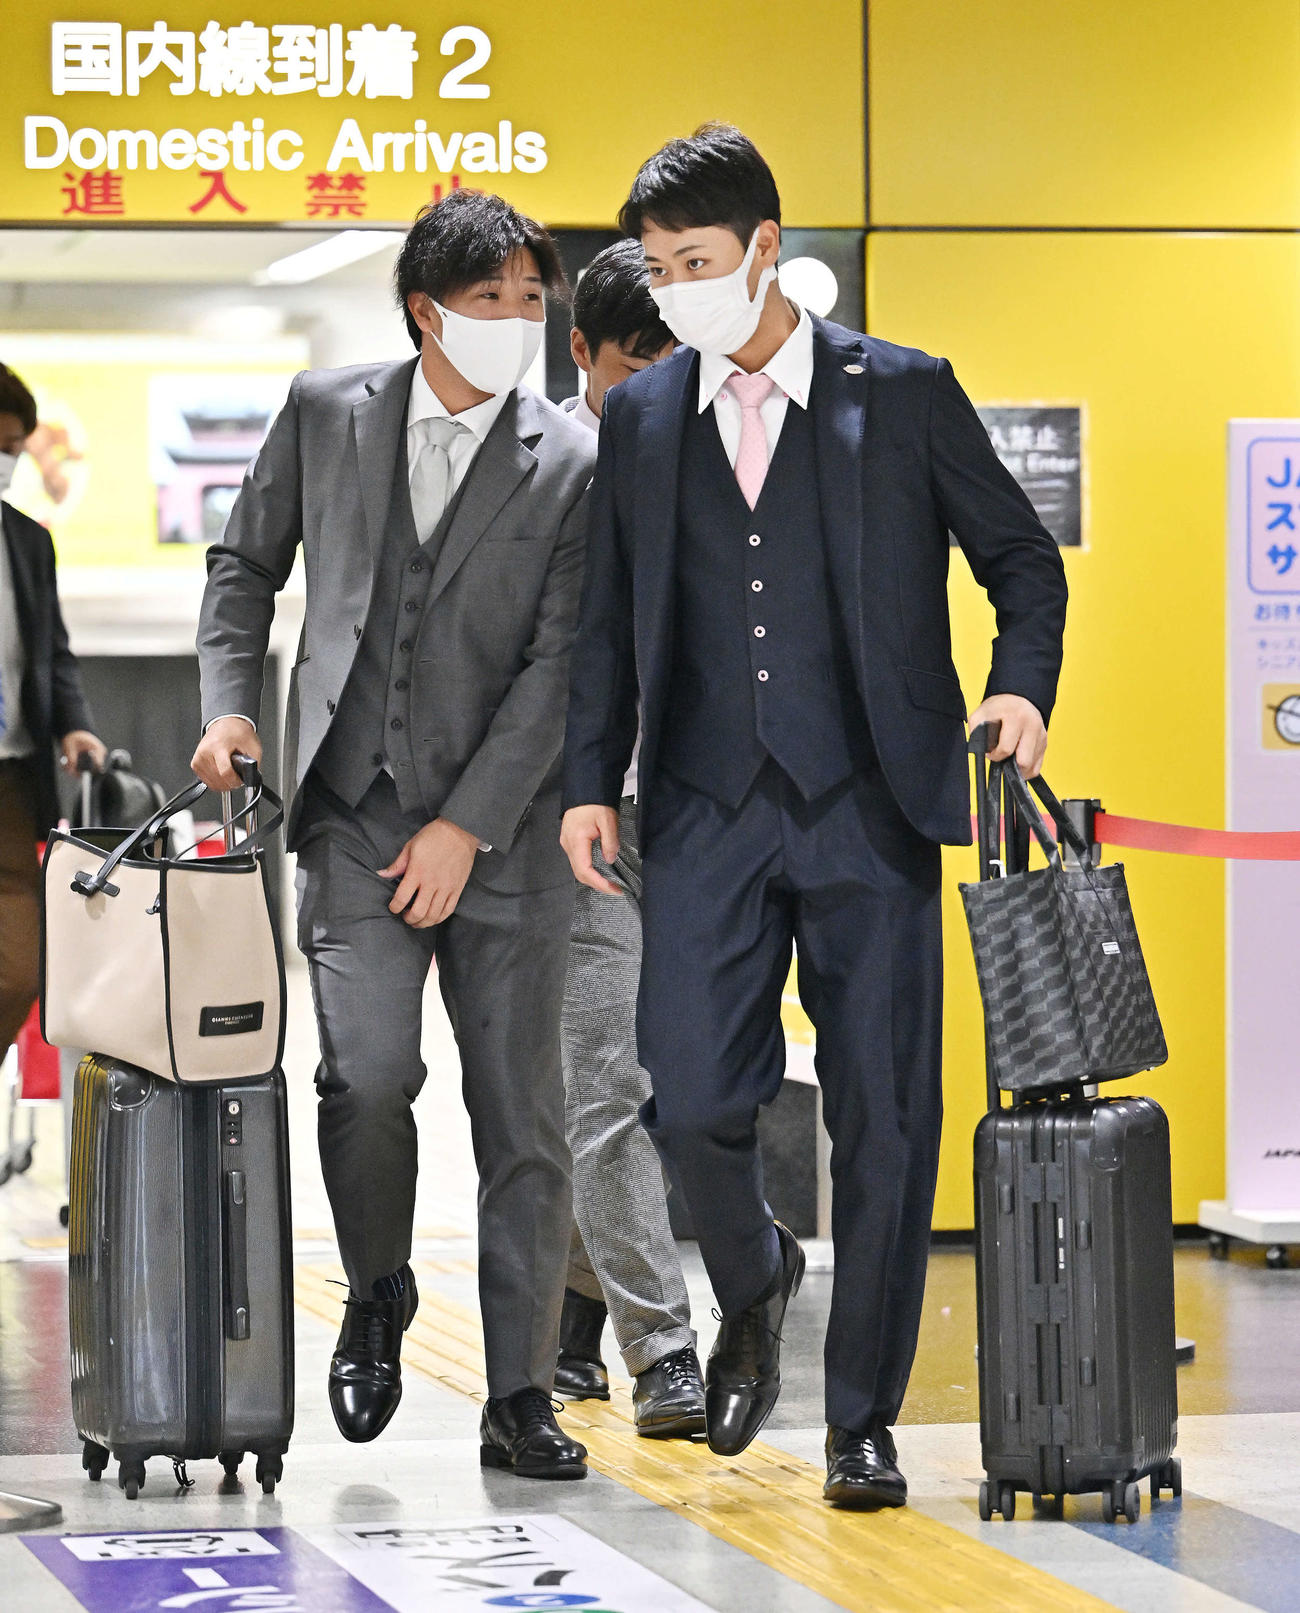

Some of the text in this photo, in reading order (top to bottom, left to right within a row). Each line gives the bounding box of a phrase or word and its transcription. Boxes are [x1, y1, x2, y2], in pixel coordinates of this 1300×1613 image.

[51, 20, 492, 99] 国内線到着 2
[24, 115, 548, 173] Domestic Arrivals
[1266, 457, 1300, 488] J
[1266, 503, 1300, 531] ス
